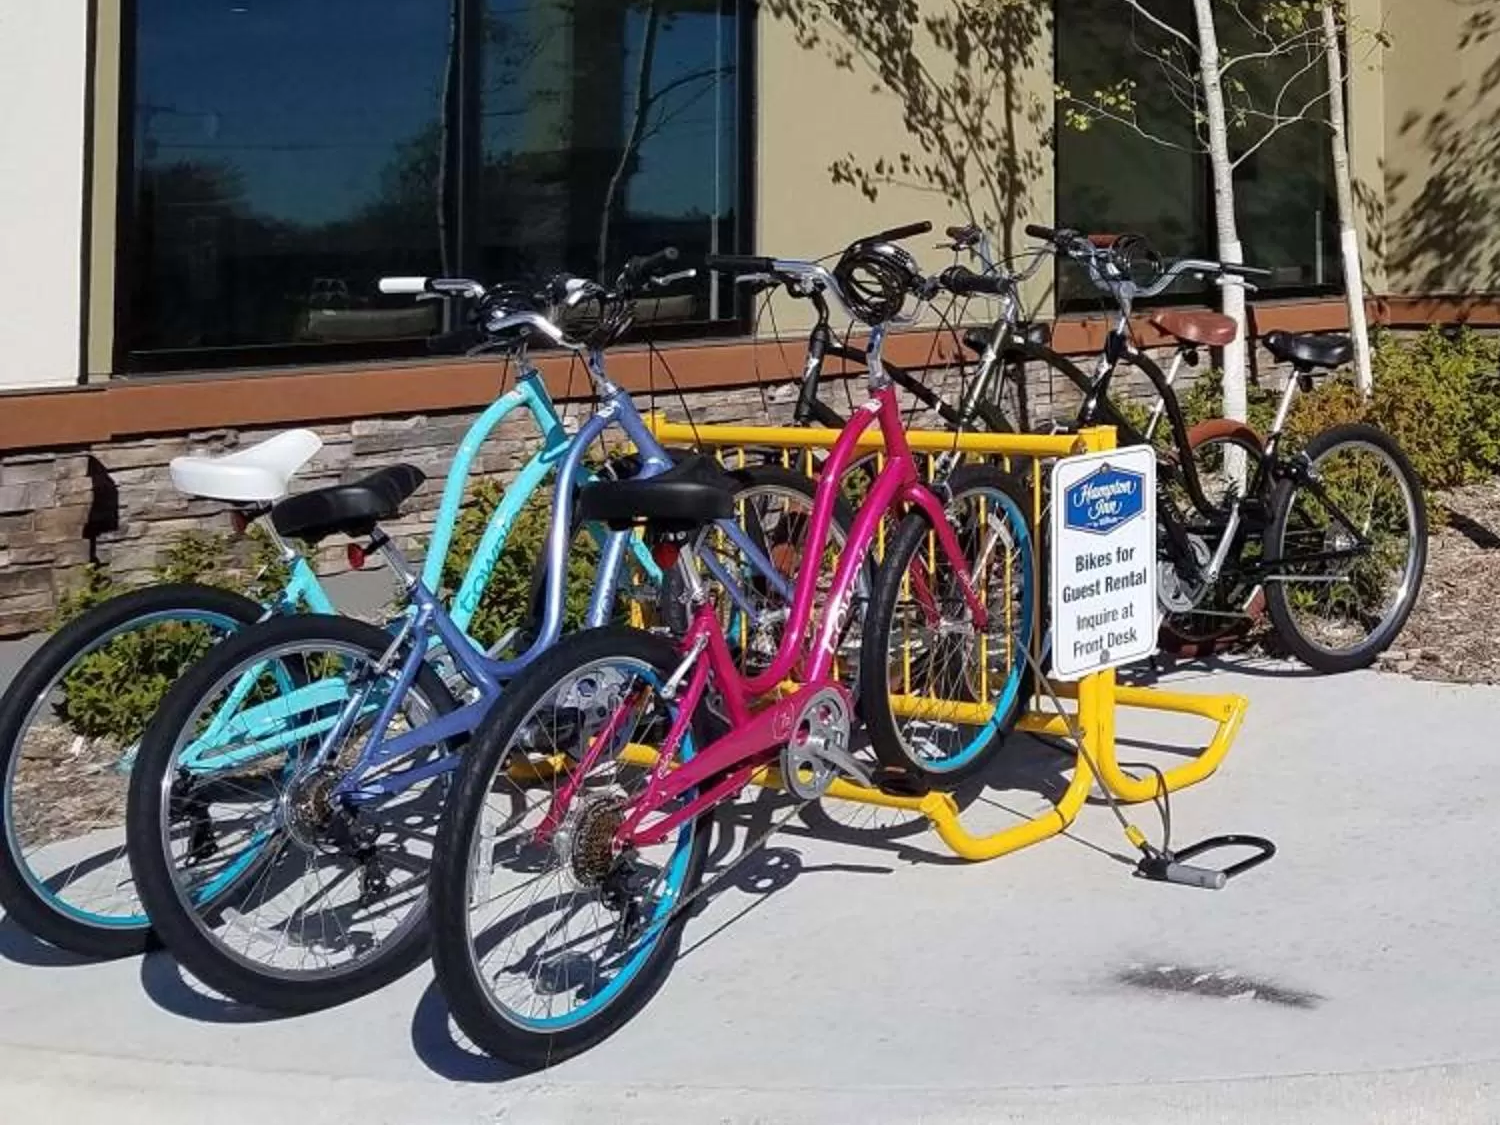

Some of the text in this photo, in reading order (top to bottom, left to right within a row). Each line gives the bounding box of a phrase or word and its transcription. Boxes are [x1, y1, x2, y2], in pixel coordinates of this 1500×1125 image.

[1073, 479, 1136, 507] Hampton
[1087, 498, 1123, 520] Inn
[1075, 546, 1136, 573] Bikes for
[1063, 566, 1147, 604] Guest Rental
[1076, 601, 1135, 632] Inquire at
[1073, 626, 1137, 659] Front Desk
